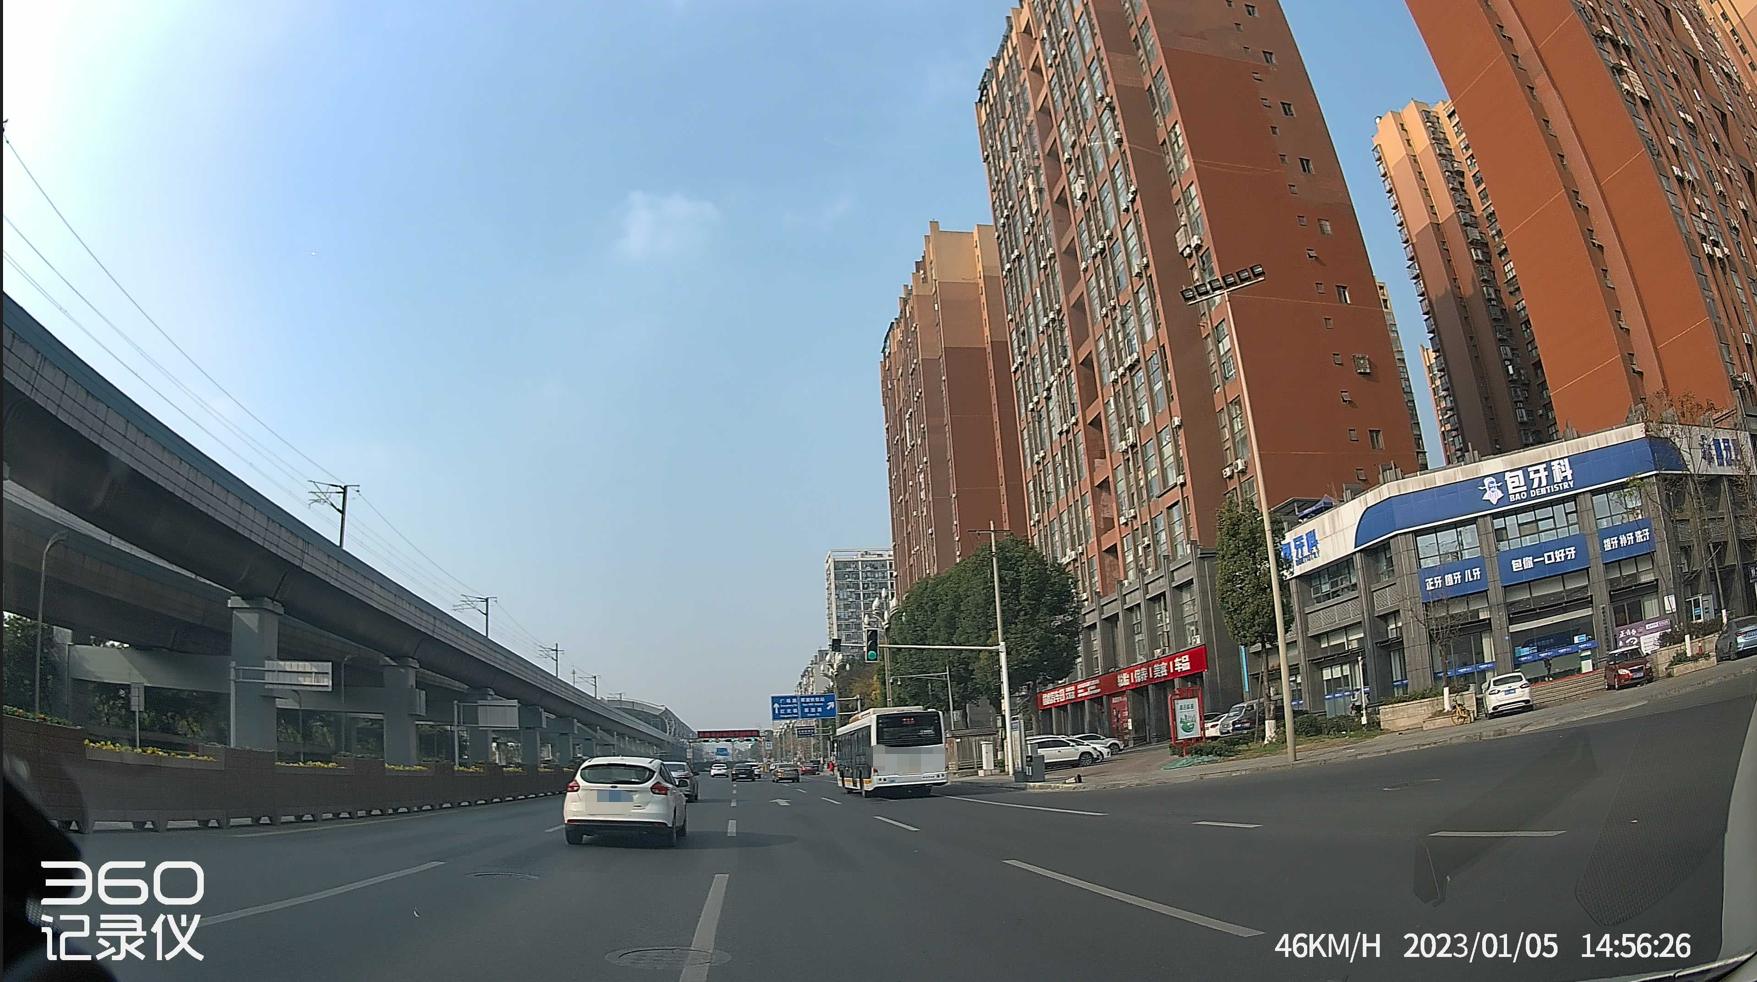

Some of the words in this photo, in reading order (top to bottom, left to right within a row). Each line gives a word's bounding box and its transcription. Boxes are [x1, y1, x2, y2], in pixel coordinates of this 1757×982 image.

[1504, 458, 1573, 494] 包牙科
[1509, 492, 1527, 502] BAO
[1530, 480, 1574, 497] DENTISTRY
